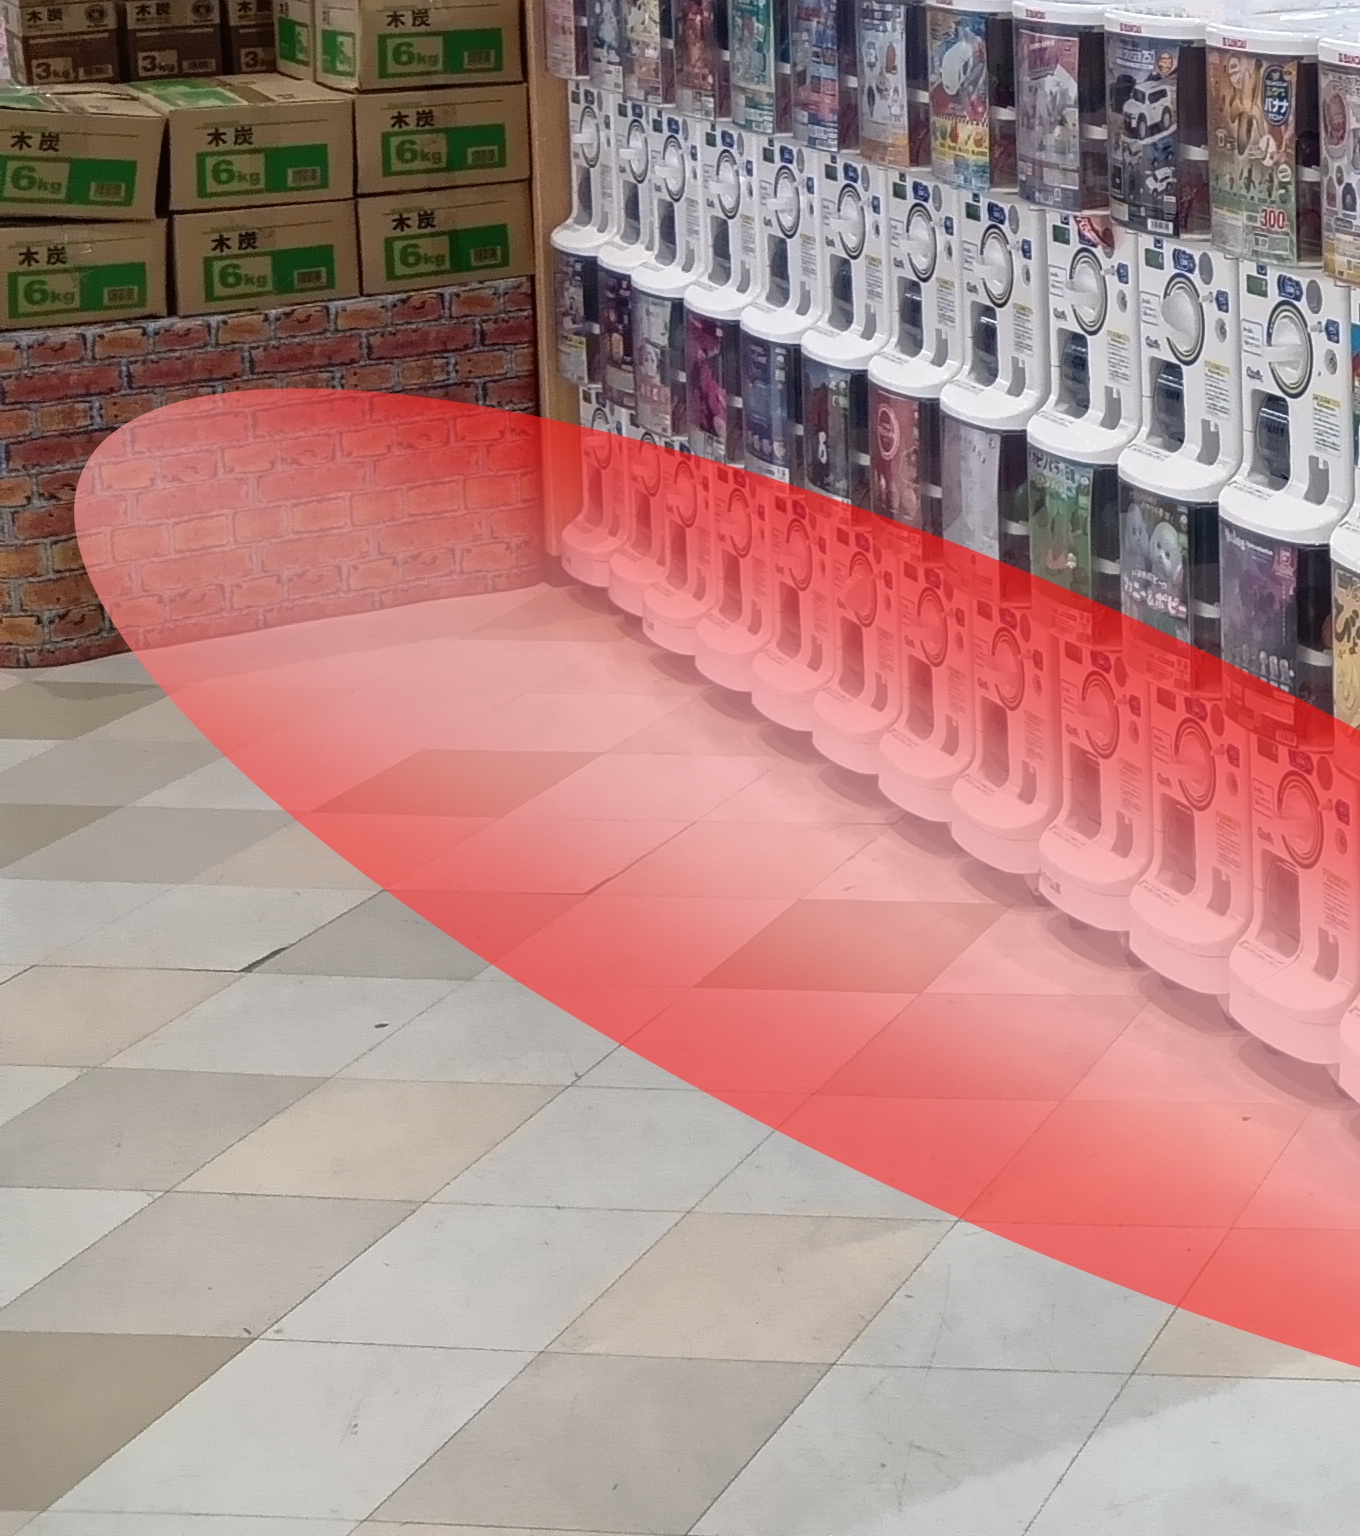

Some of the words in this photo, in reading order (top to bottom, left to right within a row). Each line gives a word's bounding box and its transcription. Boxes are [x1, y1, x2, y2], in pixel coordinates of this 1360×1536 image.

[26, 7, 64, 24] 木炭
[134, 0, 172, 18] 木炭
[386, 9, 431, 28] 木炭
[138, 52, 177, 75] 3kg
[391, 41, 440, 67] 6kg
[35, 61, 72, 82] 3kg
[1263, 97, 1290, 114] バナナ
[390, 110, 436, 129] 木炭
[11, 130, 60, 153] 木炭
[206, 126, 255, 148] 木炭
[394, 137, 444, 166] 6kg
[11, 163, 63, 195] 6kg
[210, 159, 262, 188] 6kg
[392, 211, 437, 231] 木炭
[1260, 209, 1286, 230] 300
[210, 230, 258, 253] 木炭
[18, 245, 68, 267] 木炭
[400, 240, 448, 269] 6kg
[217, 262, 269, 293] 6kg
[23, 278, 77, 308] 6kg
